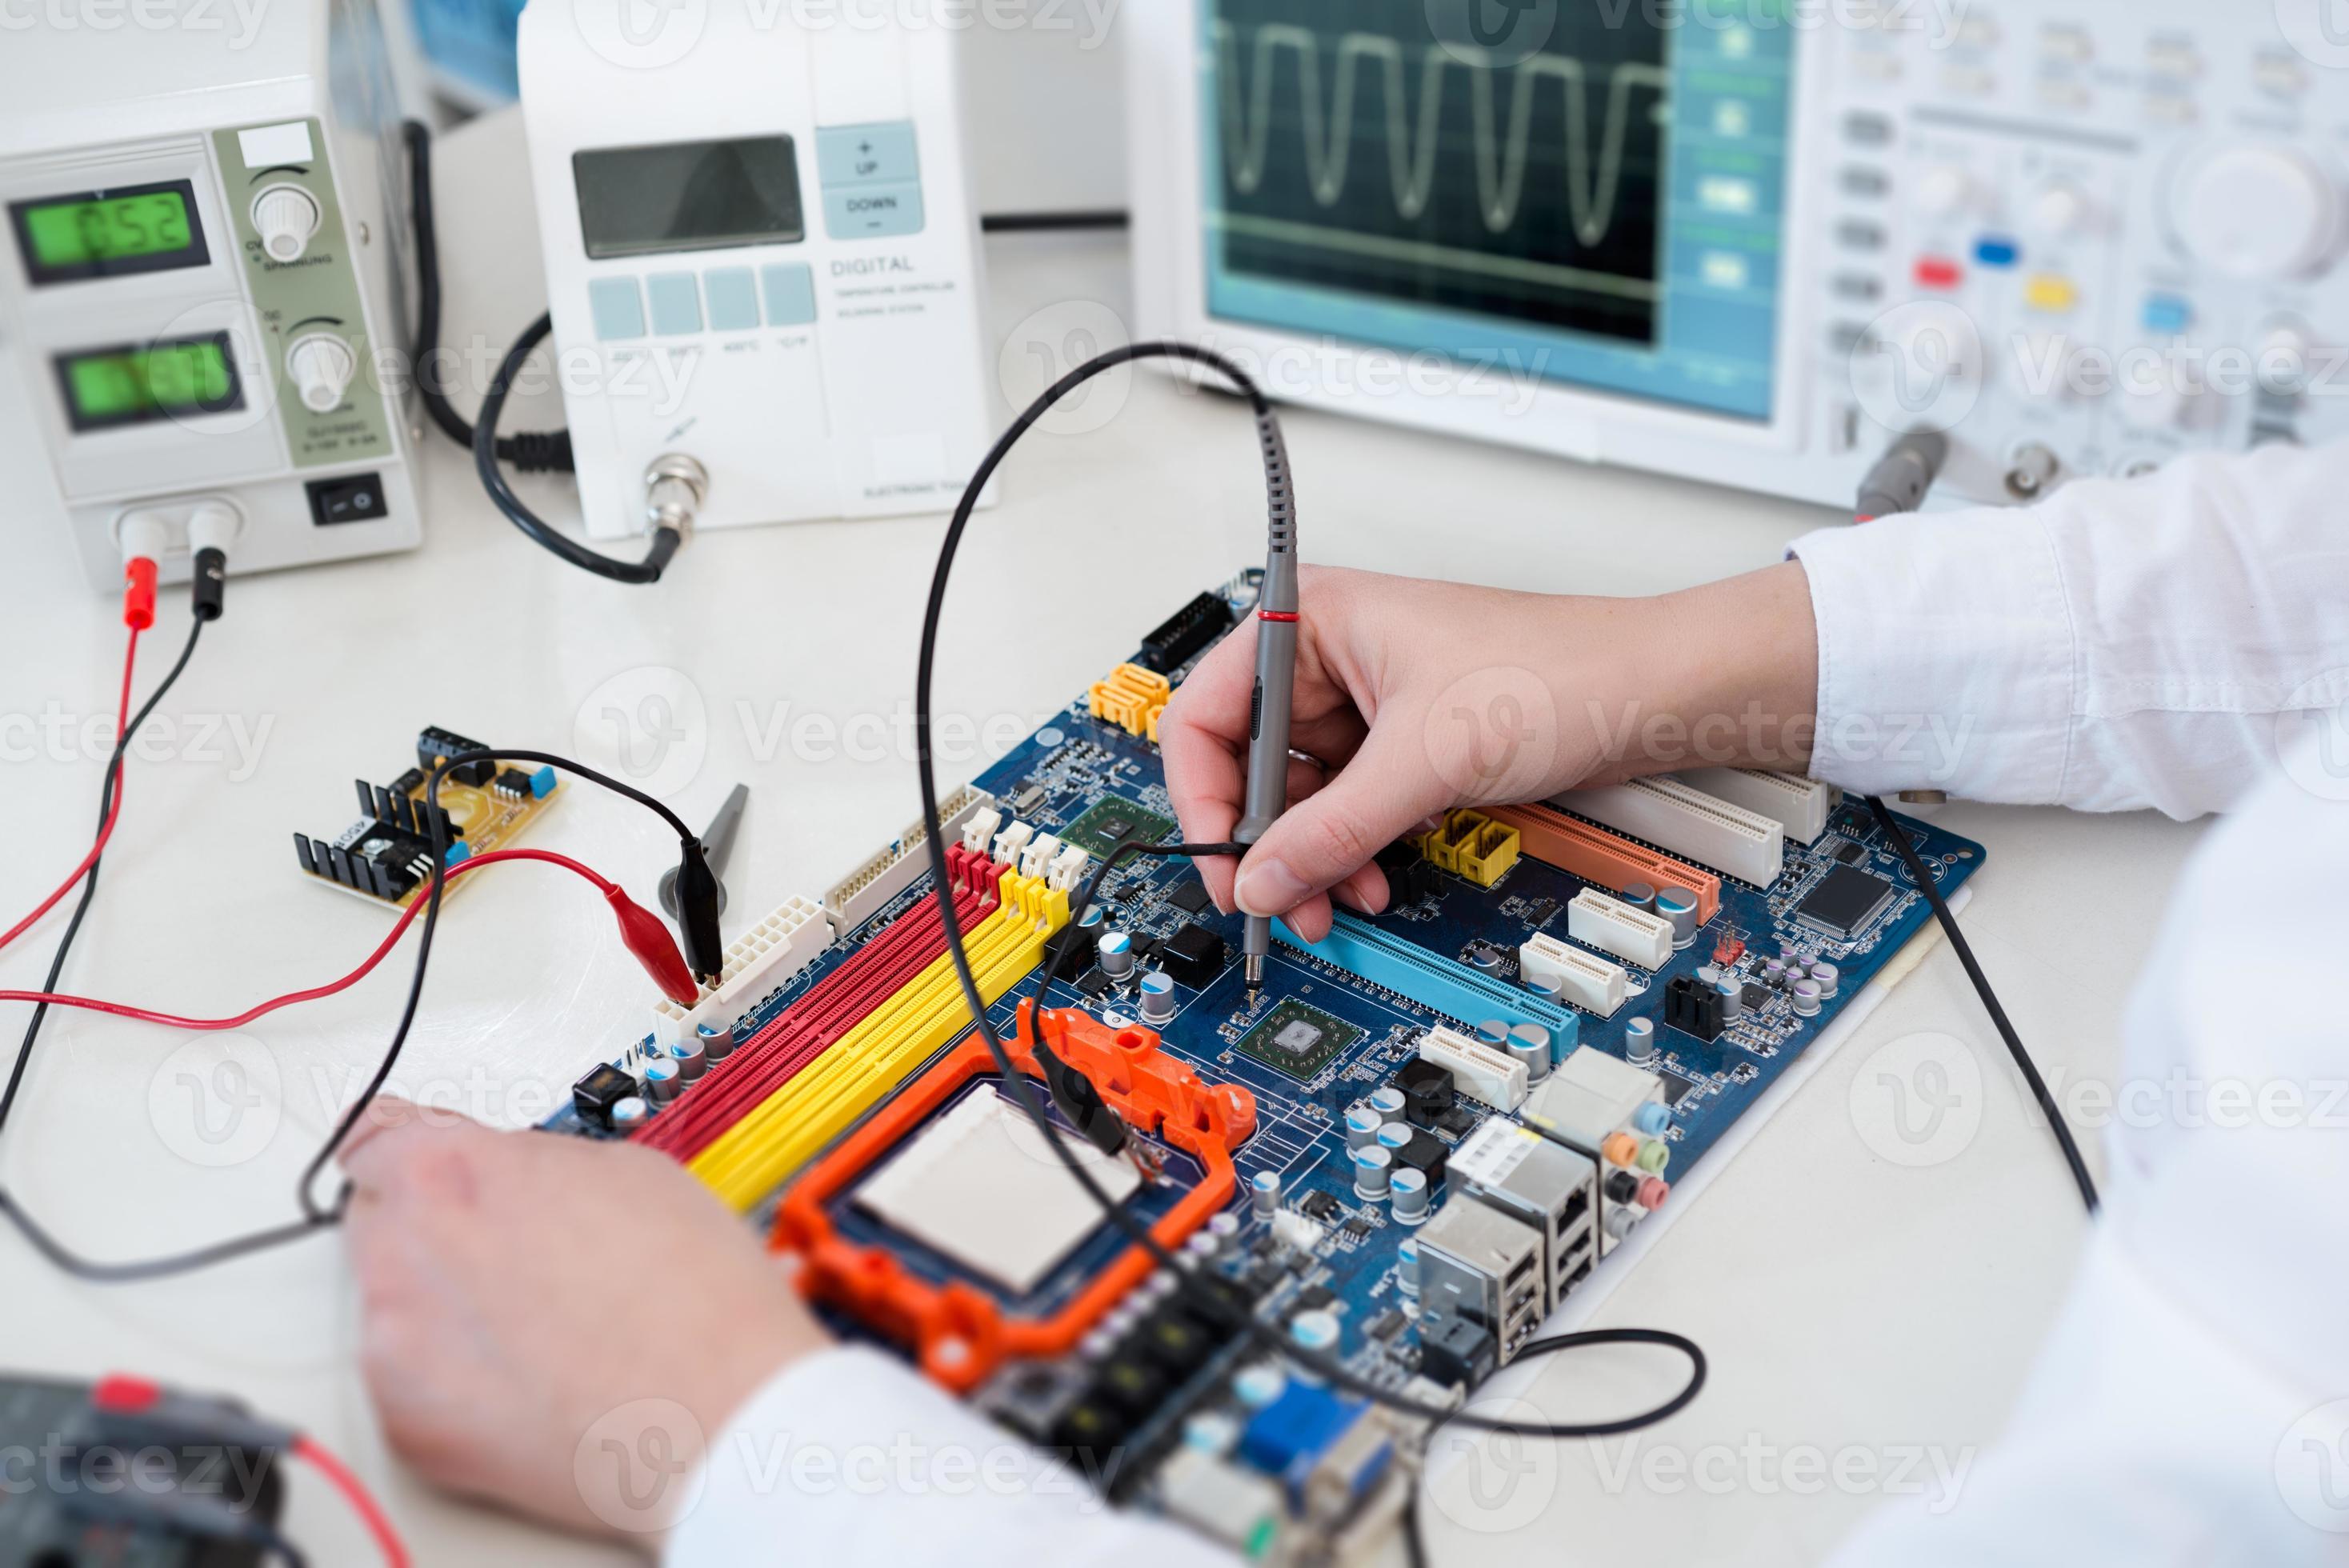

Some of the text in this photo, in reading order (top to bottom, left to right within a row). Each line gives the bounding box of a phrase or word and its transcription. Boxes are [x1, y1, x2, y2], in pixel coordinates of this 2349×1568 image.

[856, 162, 878, 175] UP
[846, 195, 898, 213] DOWN
[830, 255, 914, 277] DIGITAL
